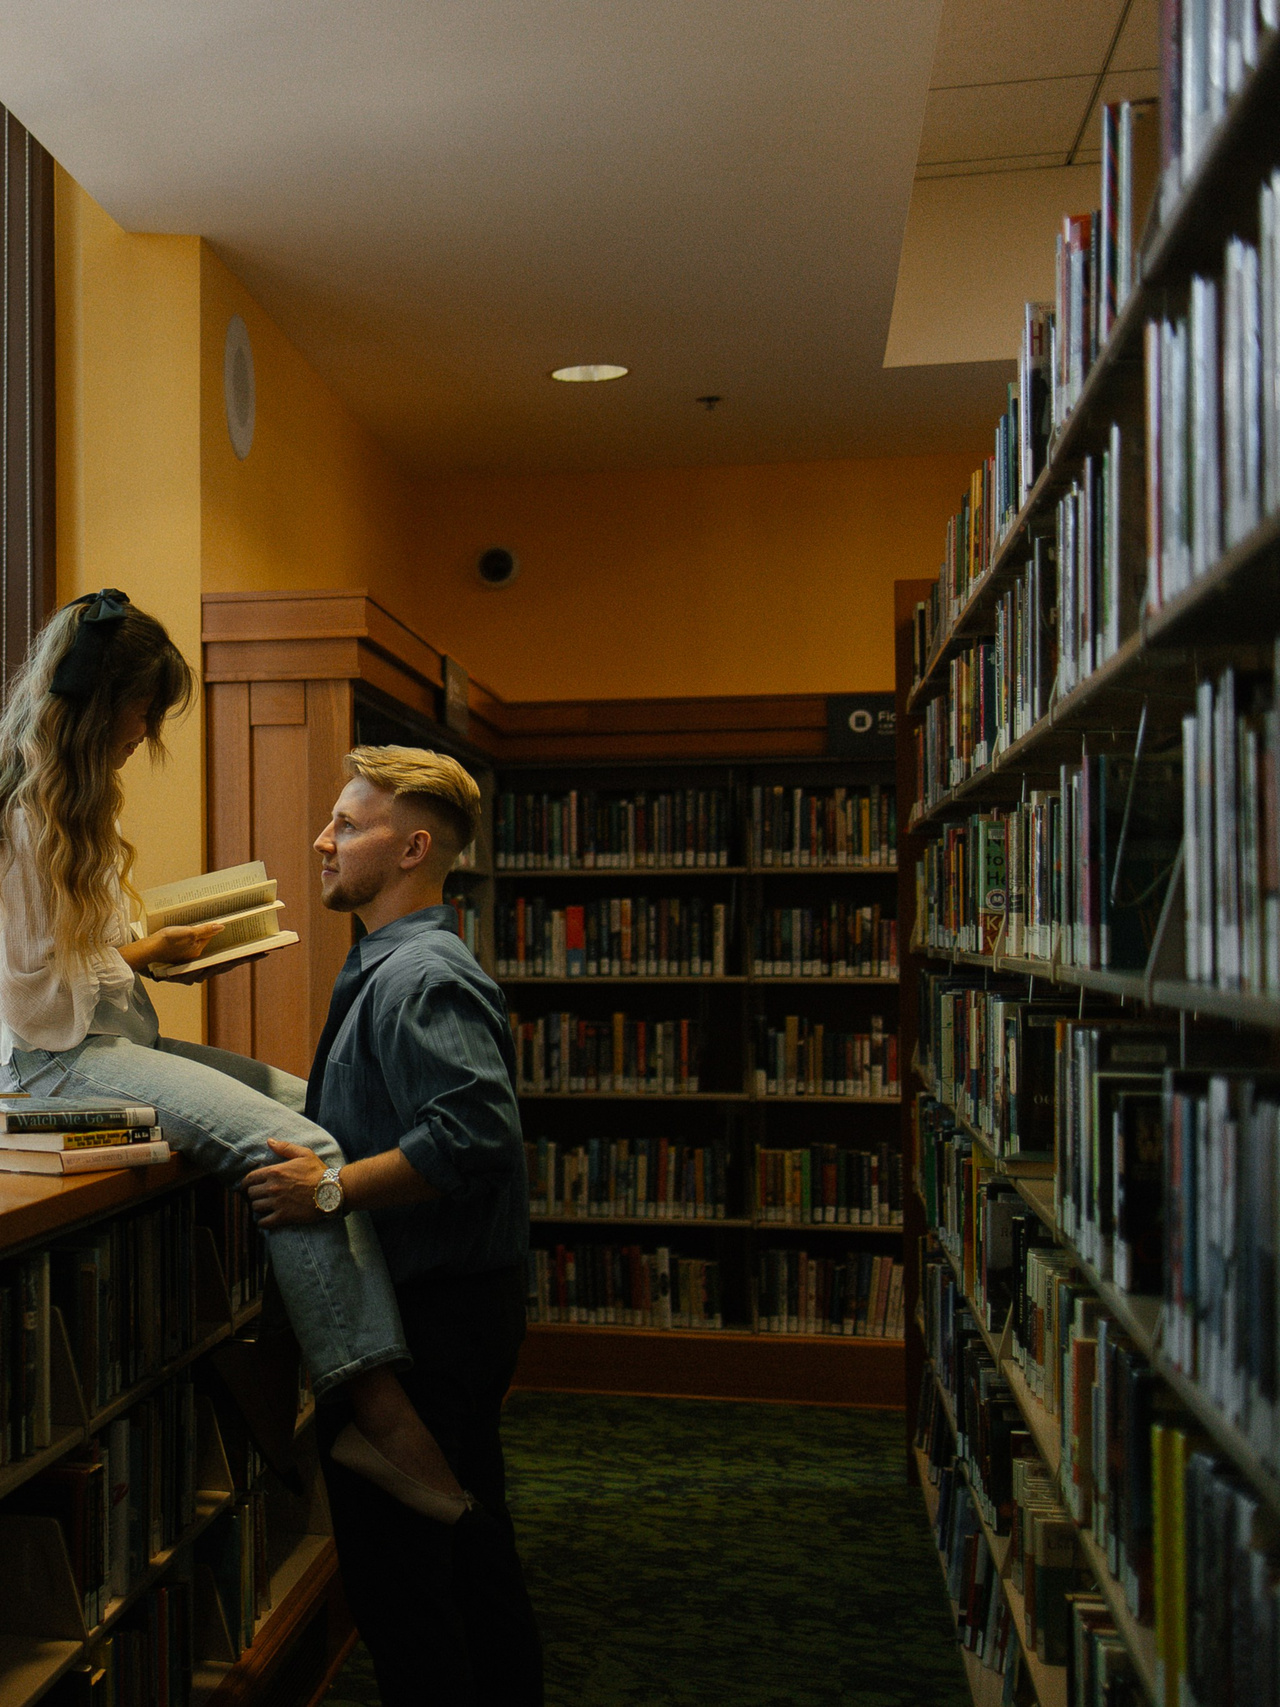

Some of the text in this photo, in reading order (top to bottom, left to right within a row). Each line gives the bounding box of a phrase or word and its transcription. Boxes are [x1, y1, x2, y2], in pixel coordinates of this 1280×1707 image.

[15, 1112, 57, 1127] Watch
[62, 1111, 81, 1125] Me
[84, 1111, 104, 1124] Go
